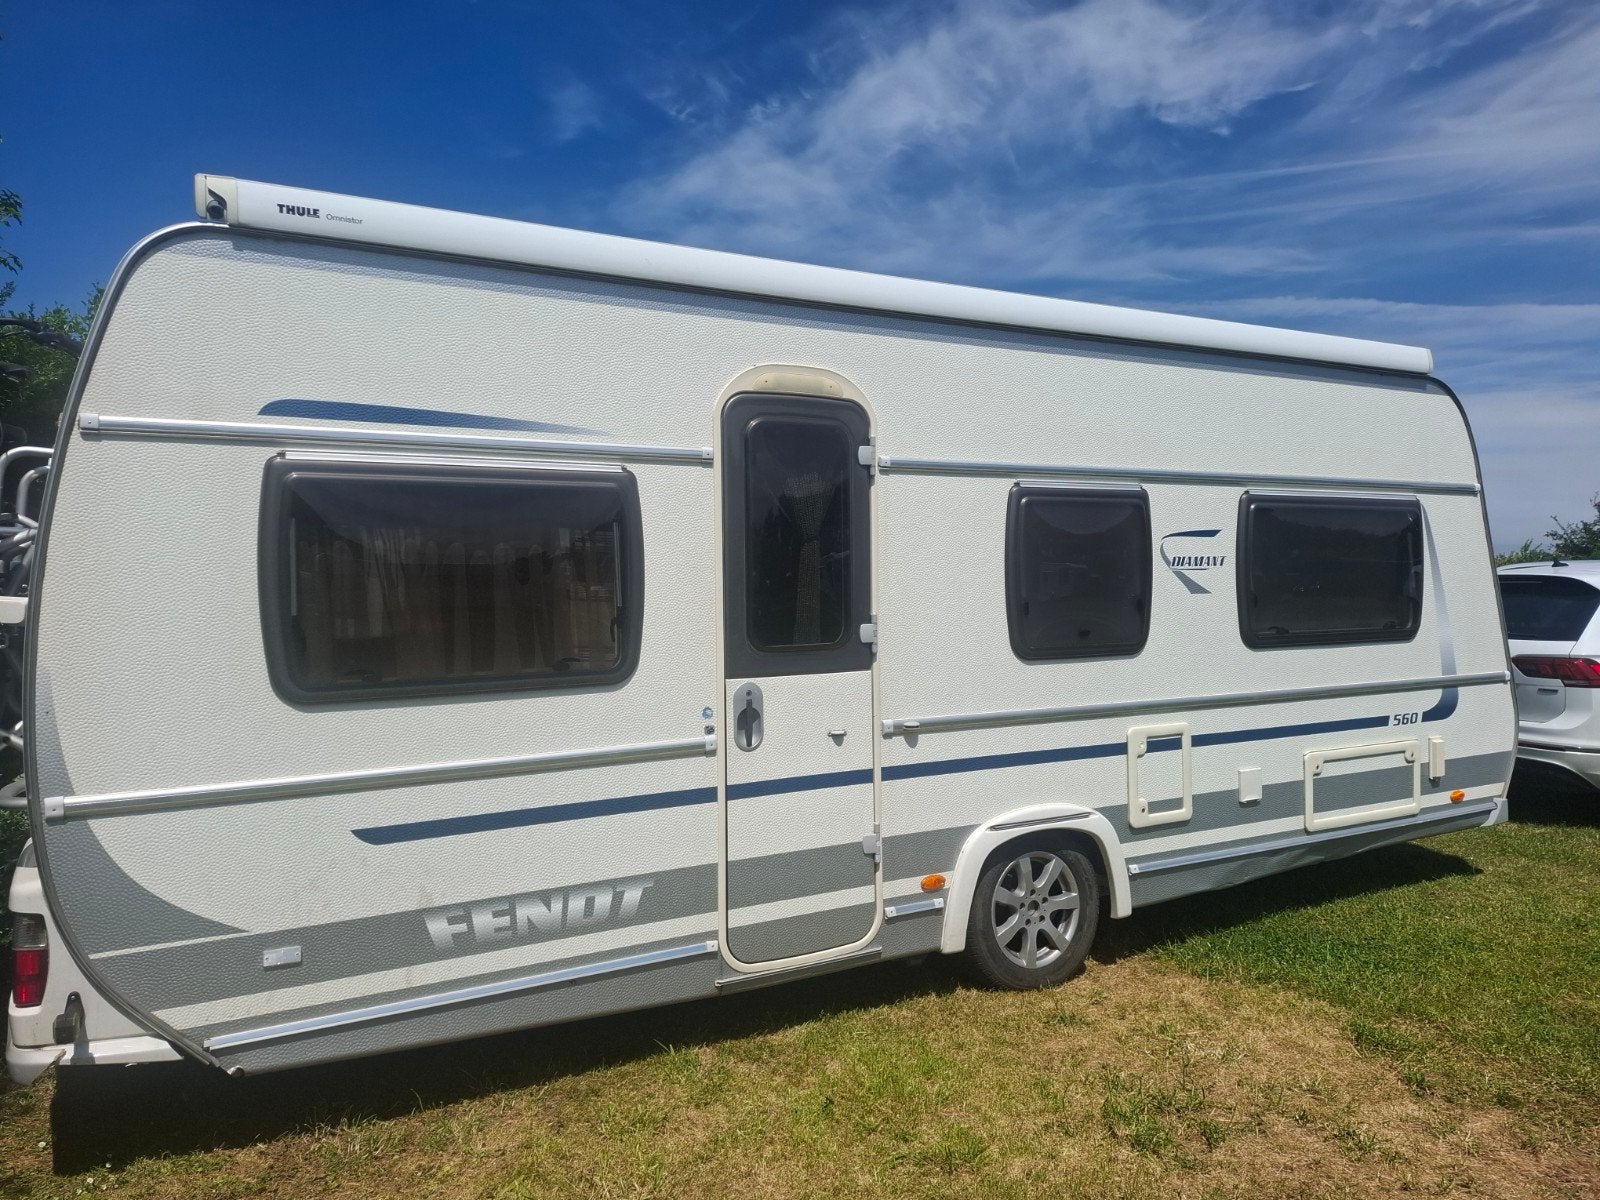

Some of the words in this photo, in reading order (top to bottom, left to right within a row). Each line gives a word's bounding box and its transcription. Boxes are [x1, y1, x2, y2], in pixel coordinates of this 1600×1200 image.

[277, 203, 320, 218] THULE
[326, 213, 364, 225] Omnistor
[1171, 556, 1227, 567] DIAMANT
[1393, 712, 1418, 726] 560
[424, 879, 653, 949] FENDT
